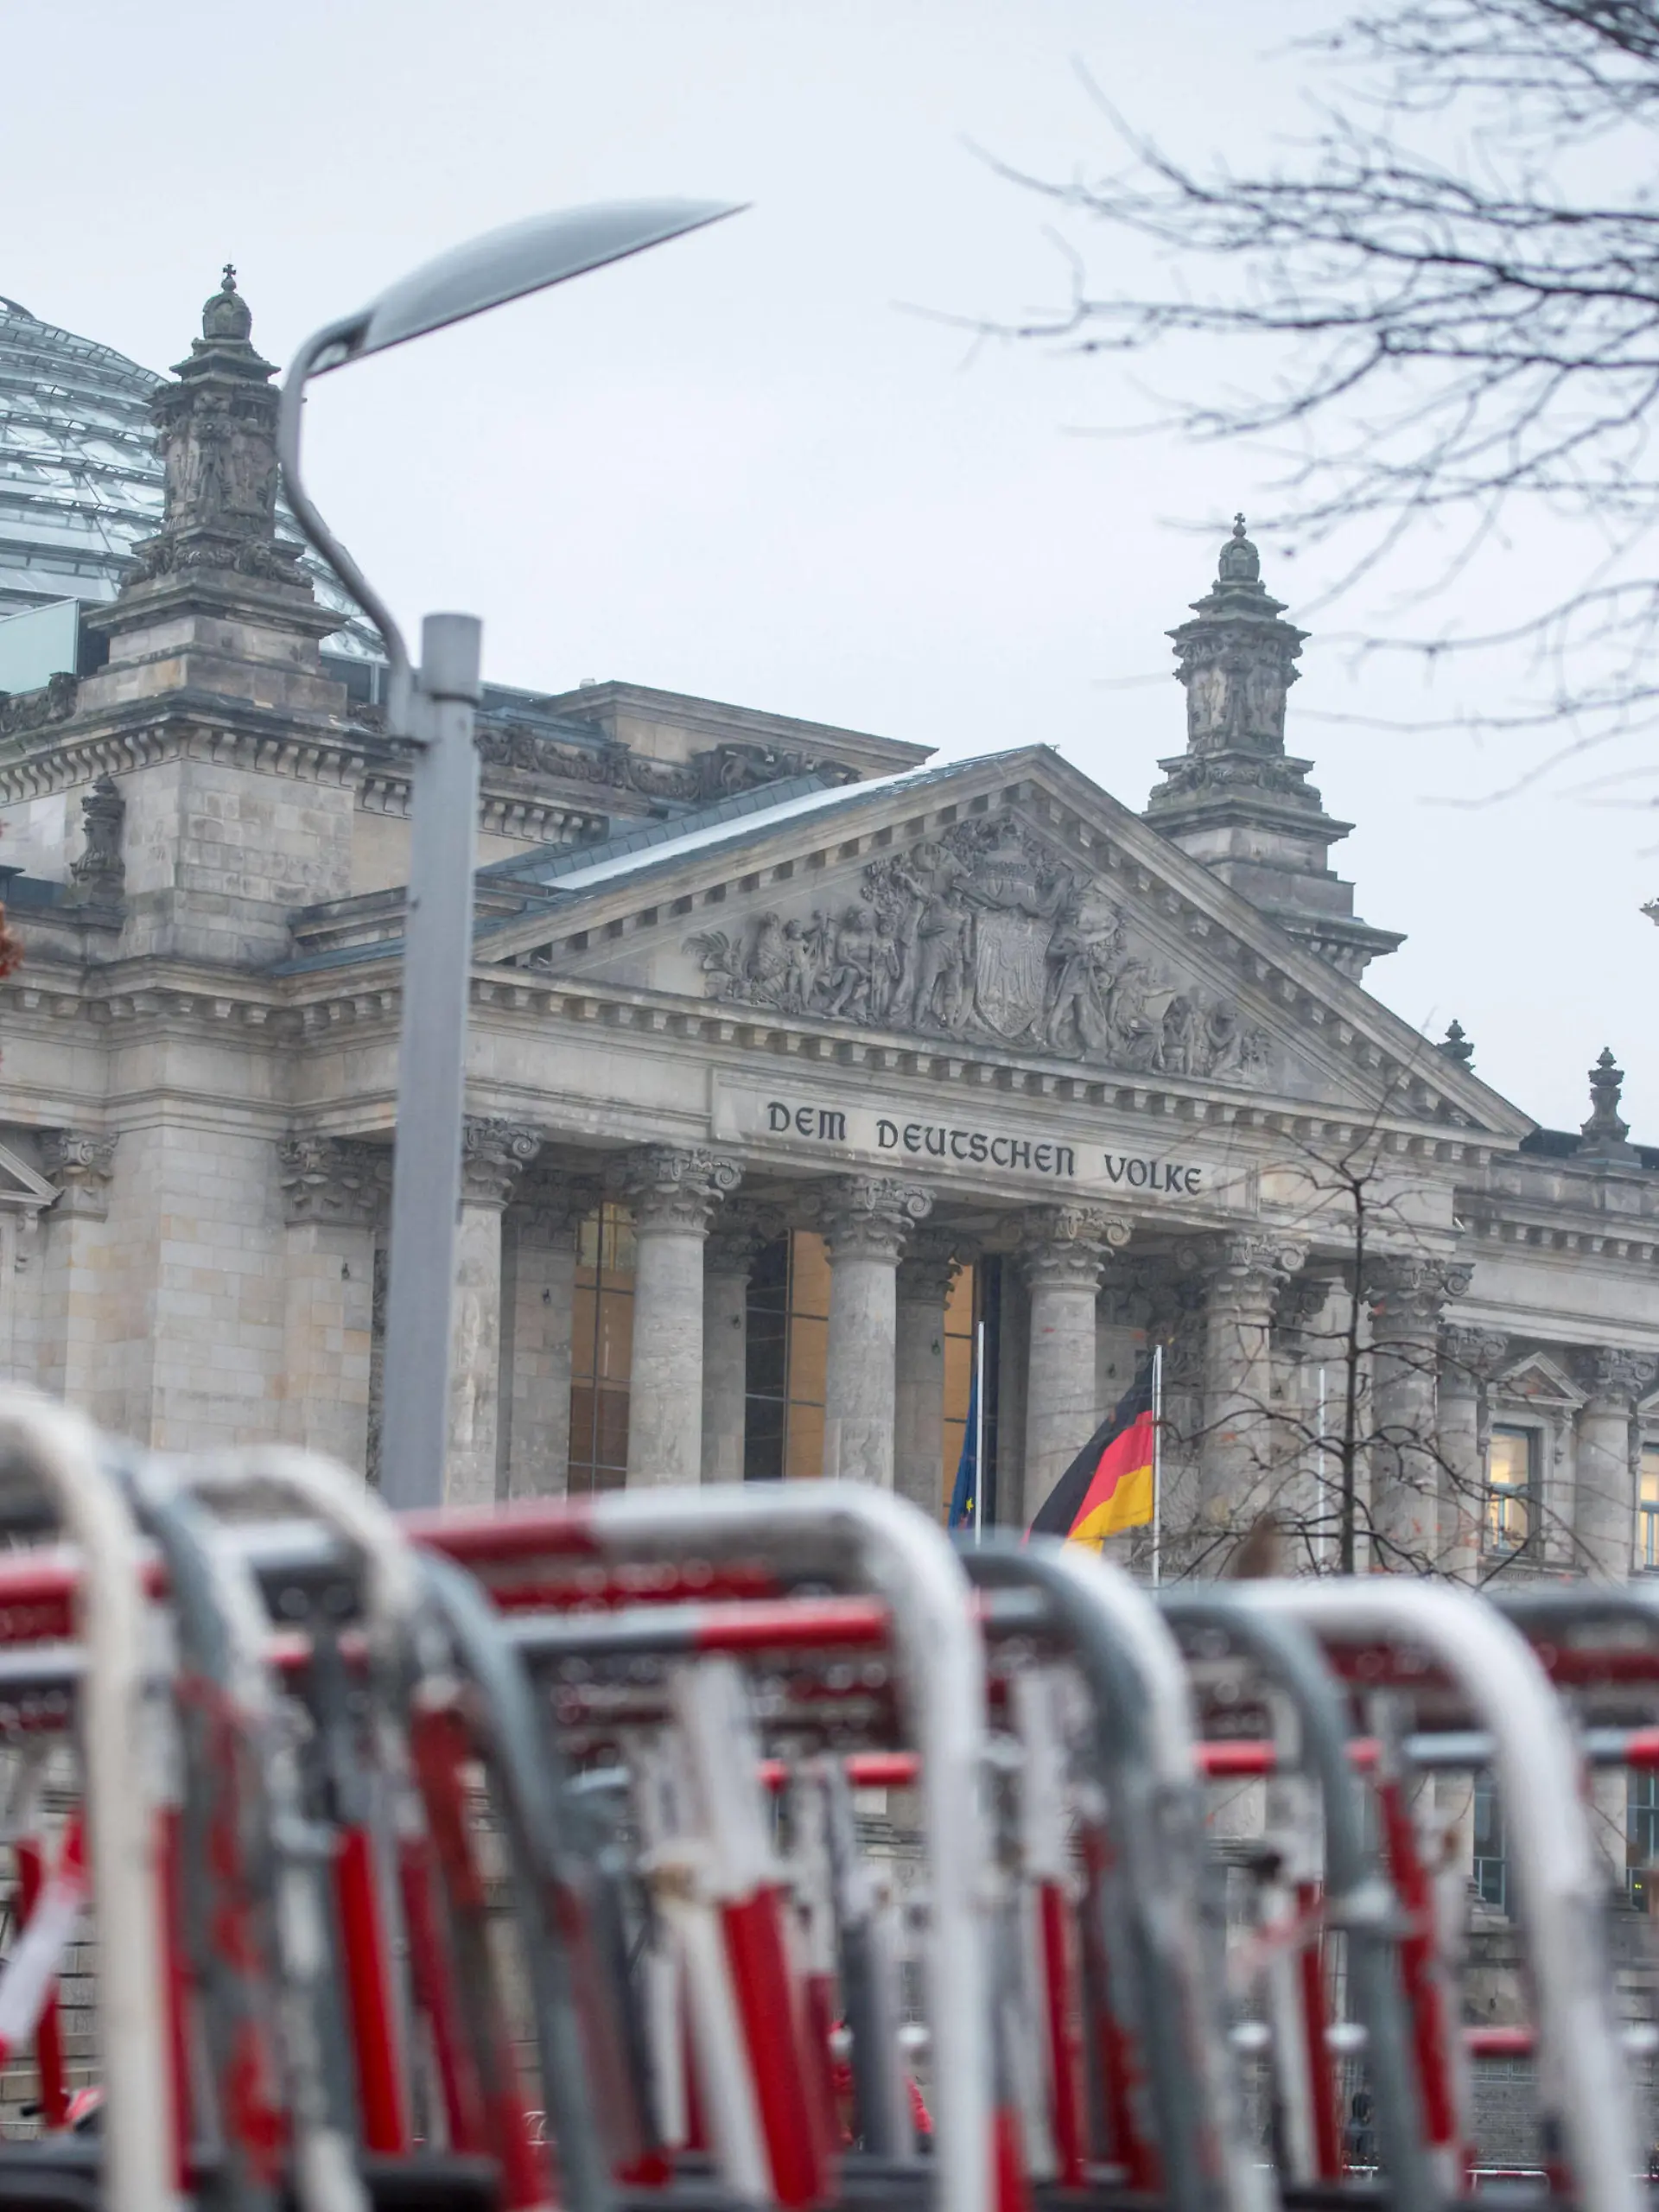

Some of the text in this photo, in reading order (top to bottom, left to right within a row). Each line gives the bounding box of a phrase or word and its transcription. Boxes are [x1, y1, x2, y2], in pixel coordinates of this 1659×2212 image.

[767, 1102, 1202, 1195] DEM DEUTSCHEN VOLKE
